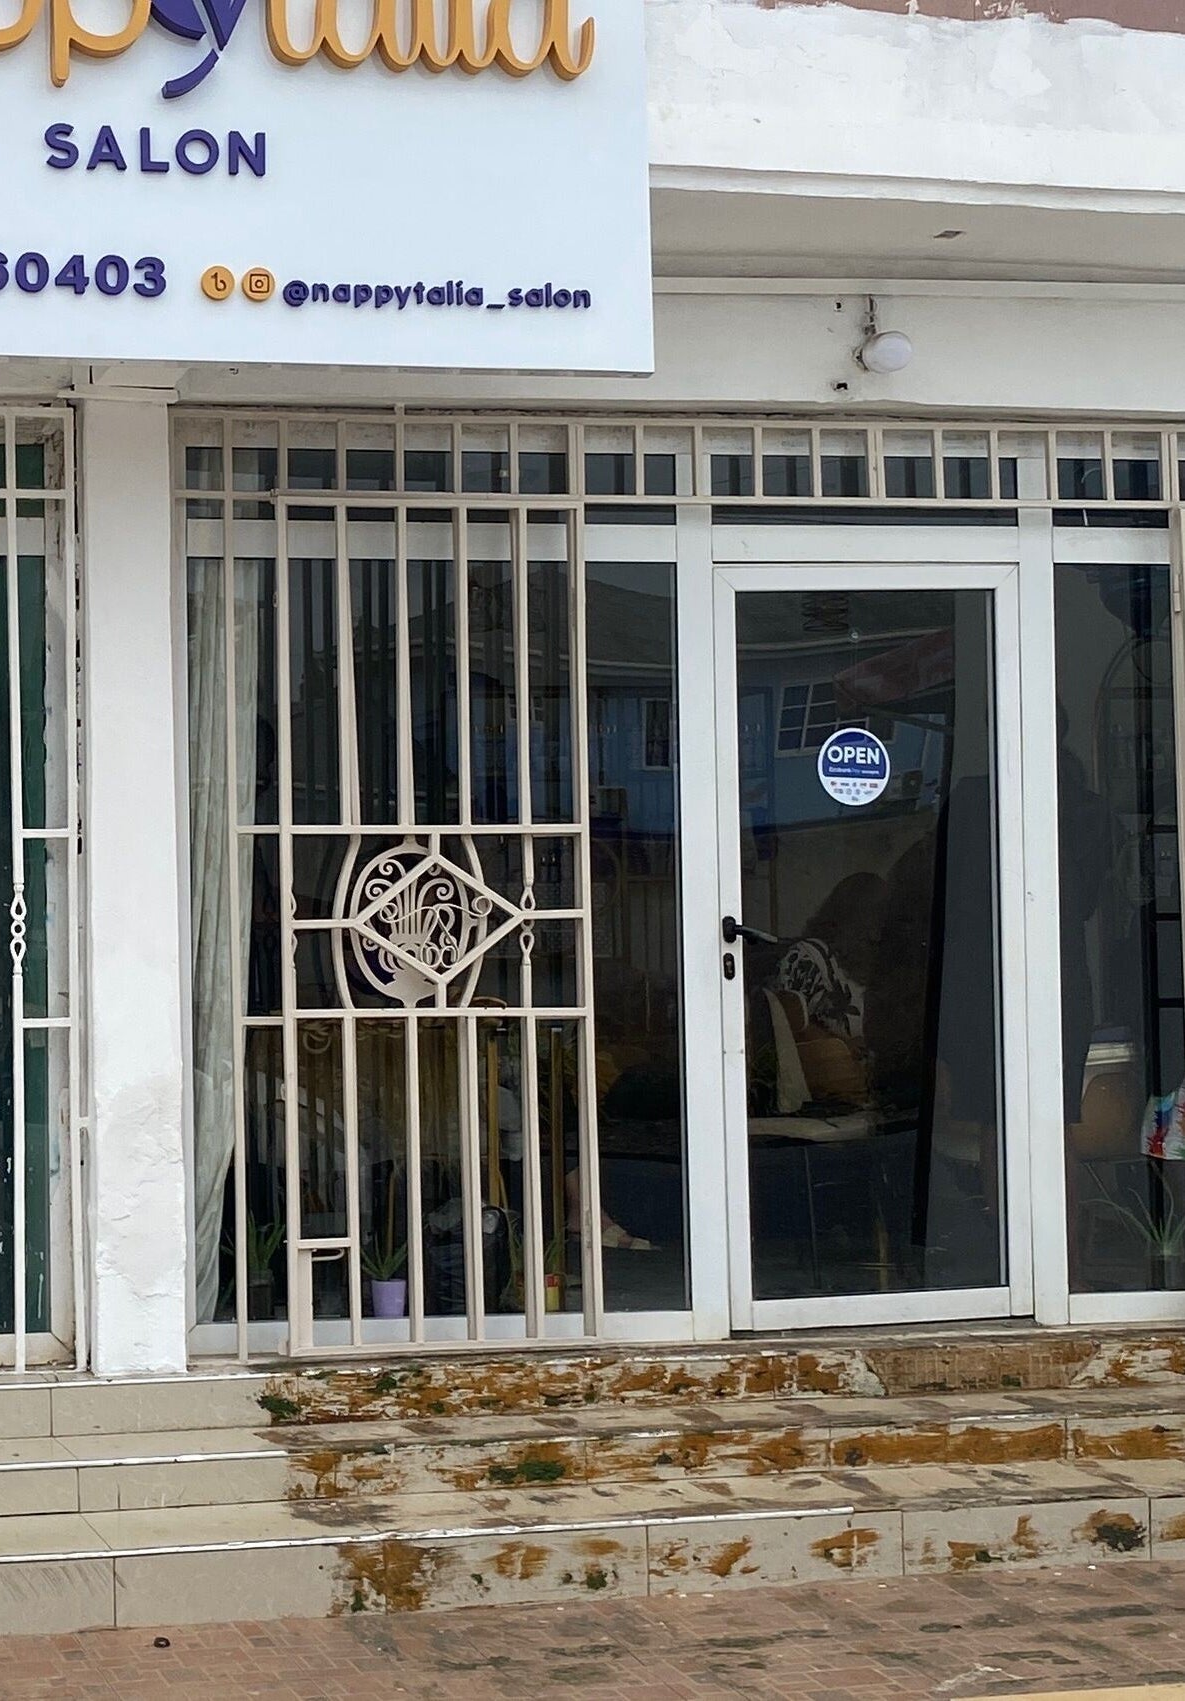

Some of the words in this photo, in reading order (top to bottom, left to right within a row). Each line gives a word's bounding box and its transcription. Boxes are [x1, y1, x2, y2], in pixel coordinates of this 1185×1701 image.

[44, 122, 267, 177] SALON
[282, 279, 592, 311] @nappytalia_salon
[827, 745, 880, 765] OPEN
